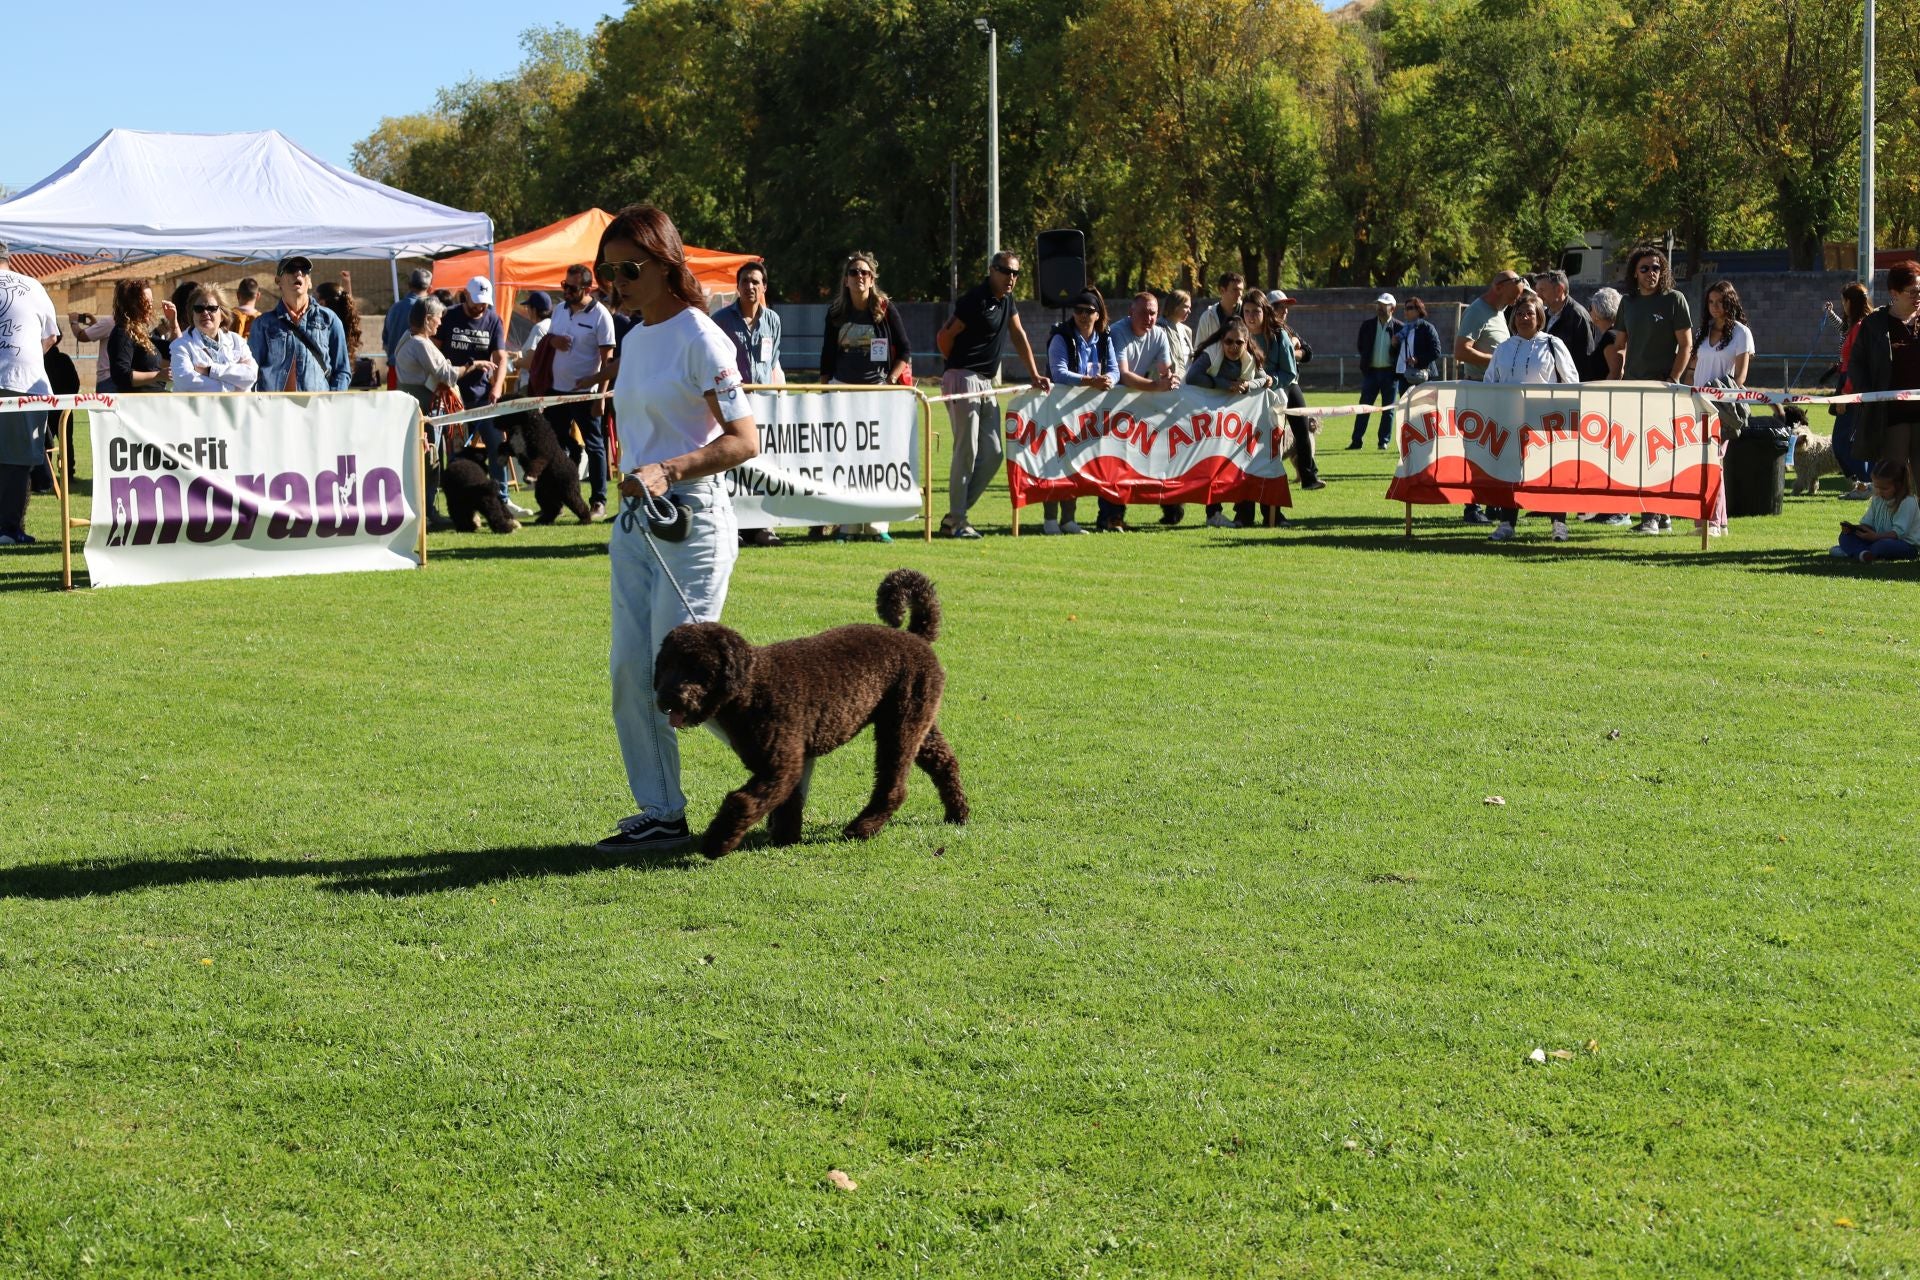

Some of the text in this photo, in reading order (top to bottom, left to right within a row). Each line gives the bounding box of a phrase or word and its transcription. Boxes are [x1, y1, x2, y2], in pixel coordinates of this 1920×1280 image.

[451, 341, 469, 350] RAW
[856, 420, 881, 451] DE
[1053, 408, 1160, 459] ARION
[1167, 411, 1261, 461] ARION
[1400, 407, 1511, 463] ARION
[1517, 409, 1637, 464] ARION
[109, 436, 229, 471] CrossFit
[832, 461, 912, 494] CAMPOS
[106, 454, 405, 547] morado
